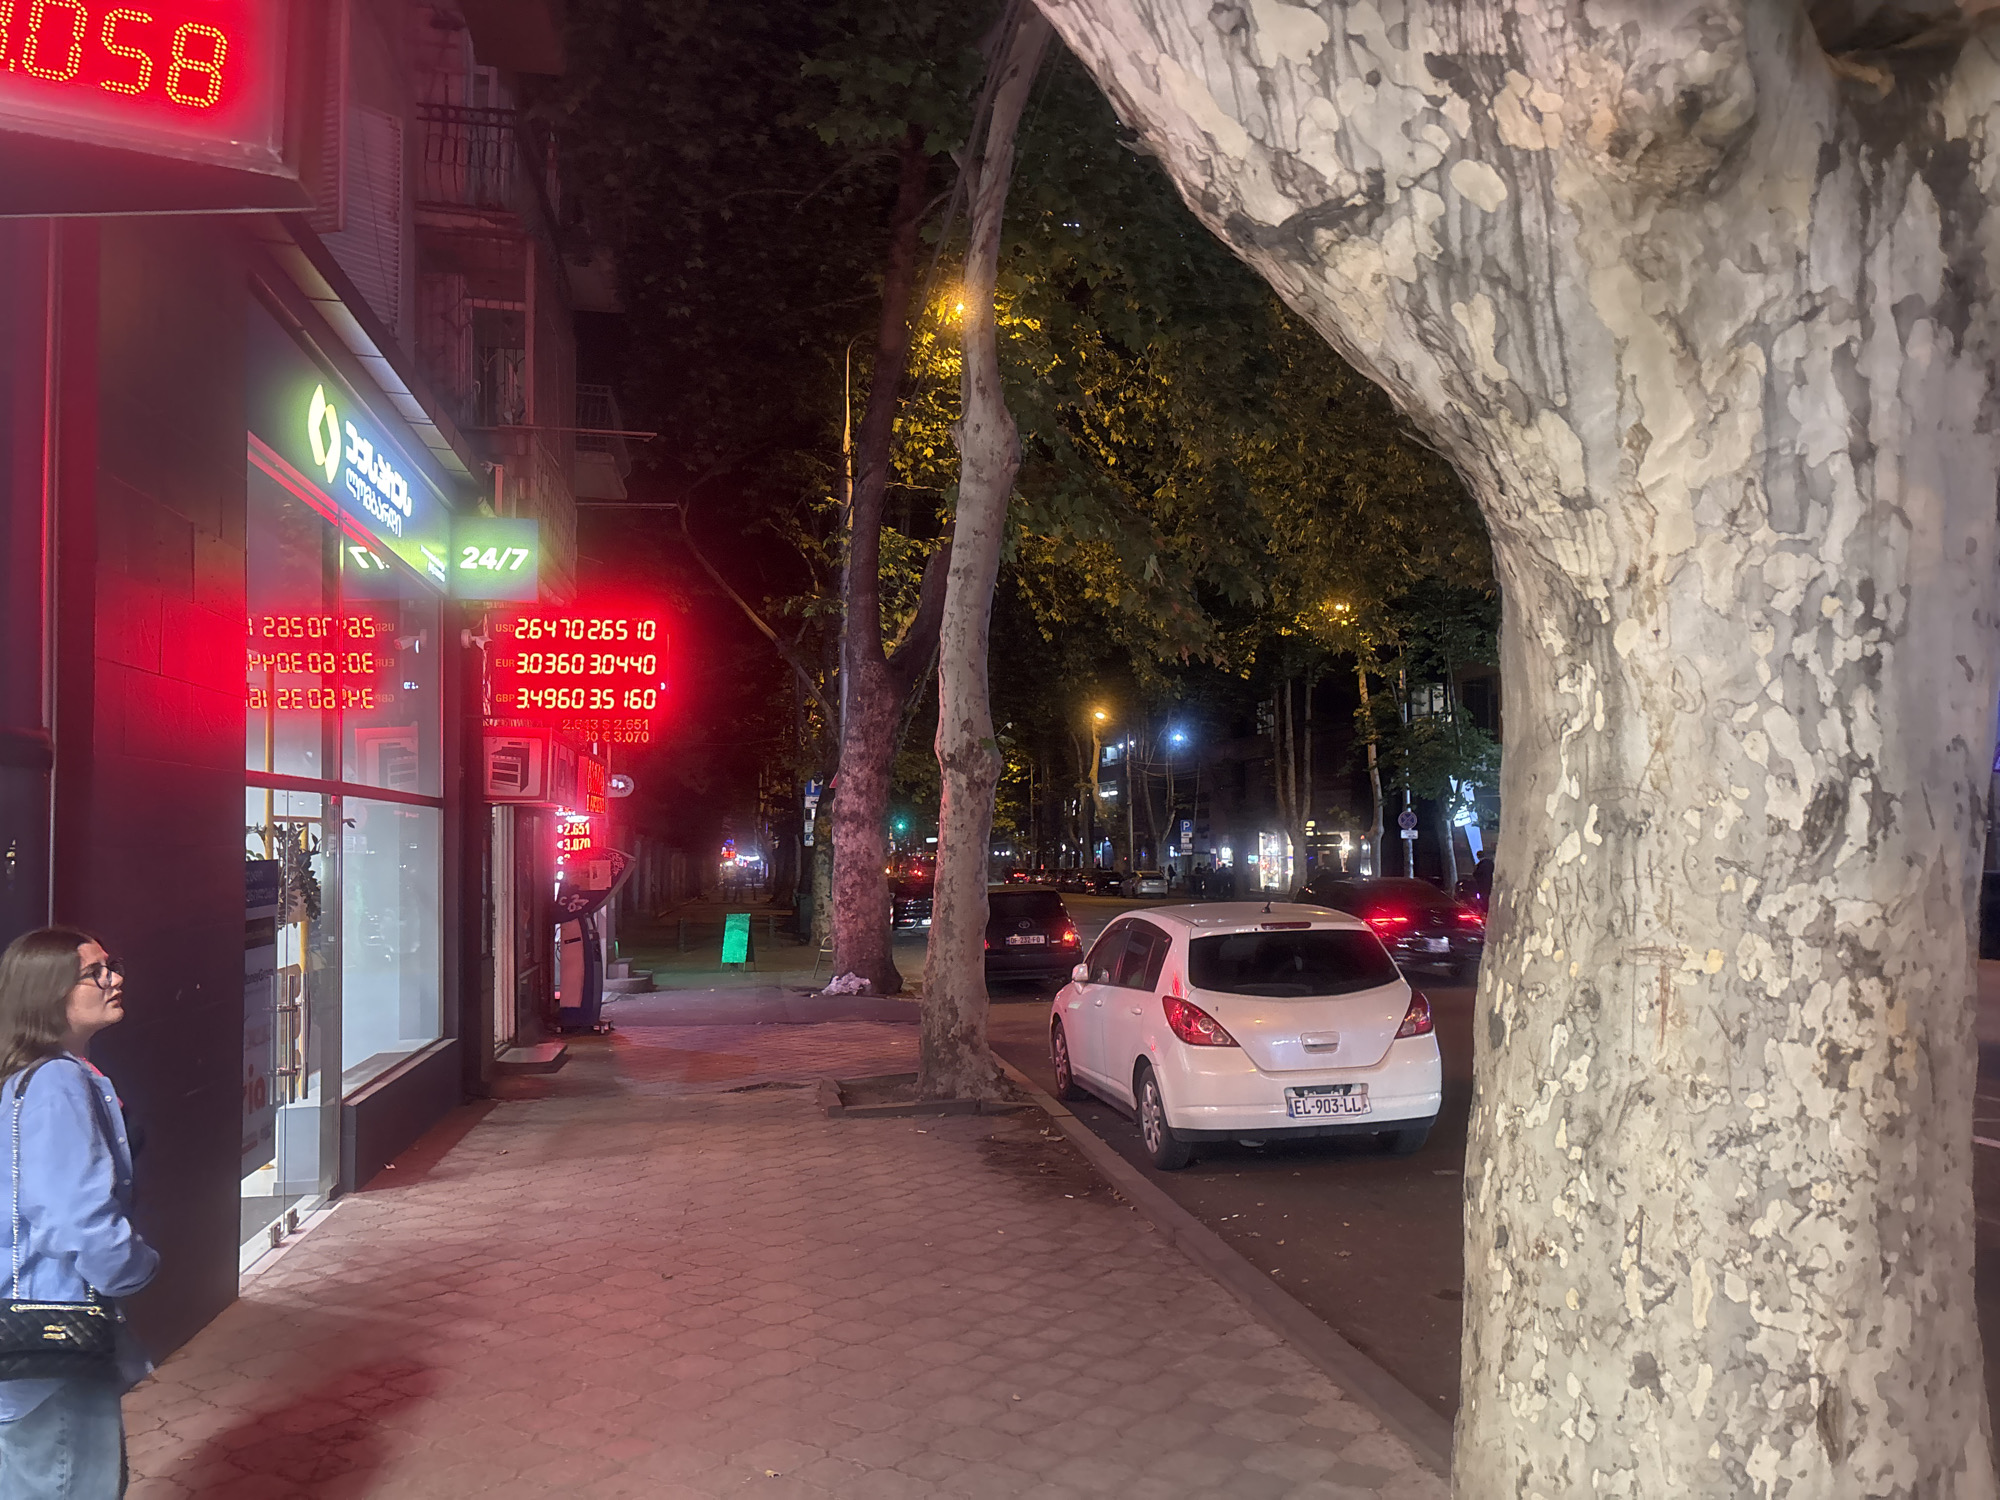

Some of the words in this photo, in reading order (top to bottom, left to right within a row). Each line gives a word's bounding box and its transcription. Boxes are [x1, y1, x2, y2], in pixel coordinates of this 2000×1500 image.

[460, 546, 529, 571] 24/7
[495, 623, 515, 633] USD
[495, 658, 515, 667] EUR
[495, 693, 515, 703] GBP
[613, 718, 649, 731] 2.651
[613, 731, 650, 743] 3.070
[564, 822, 590, 836] 2.651
[1183, 821, 1190, 831] P
[1294, 1097, 1361, 1115] EL-903-LL
